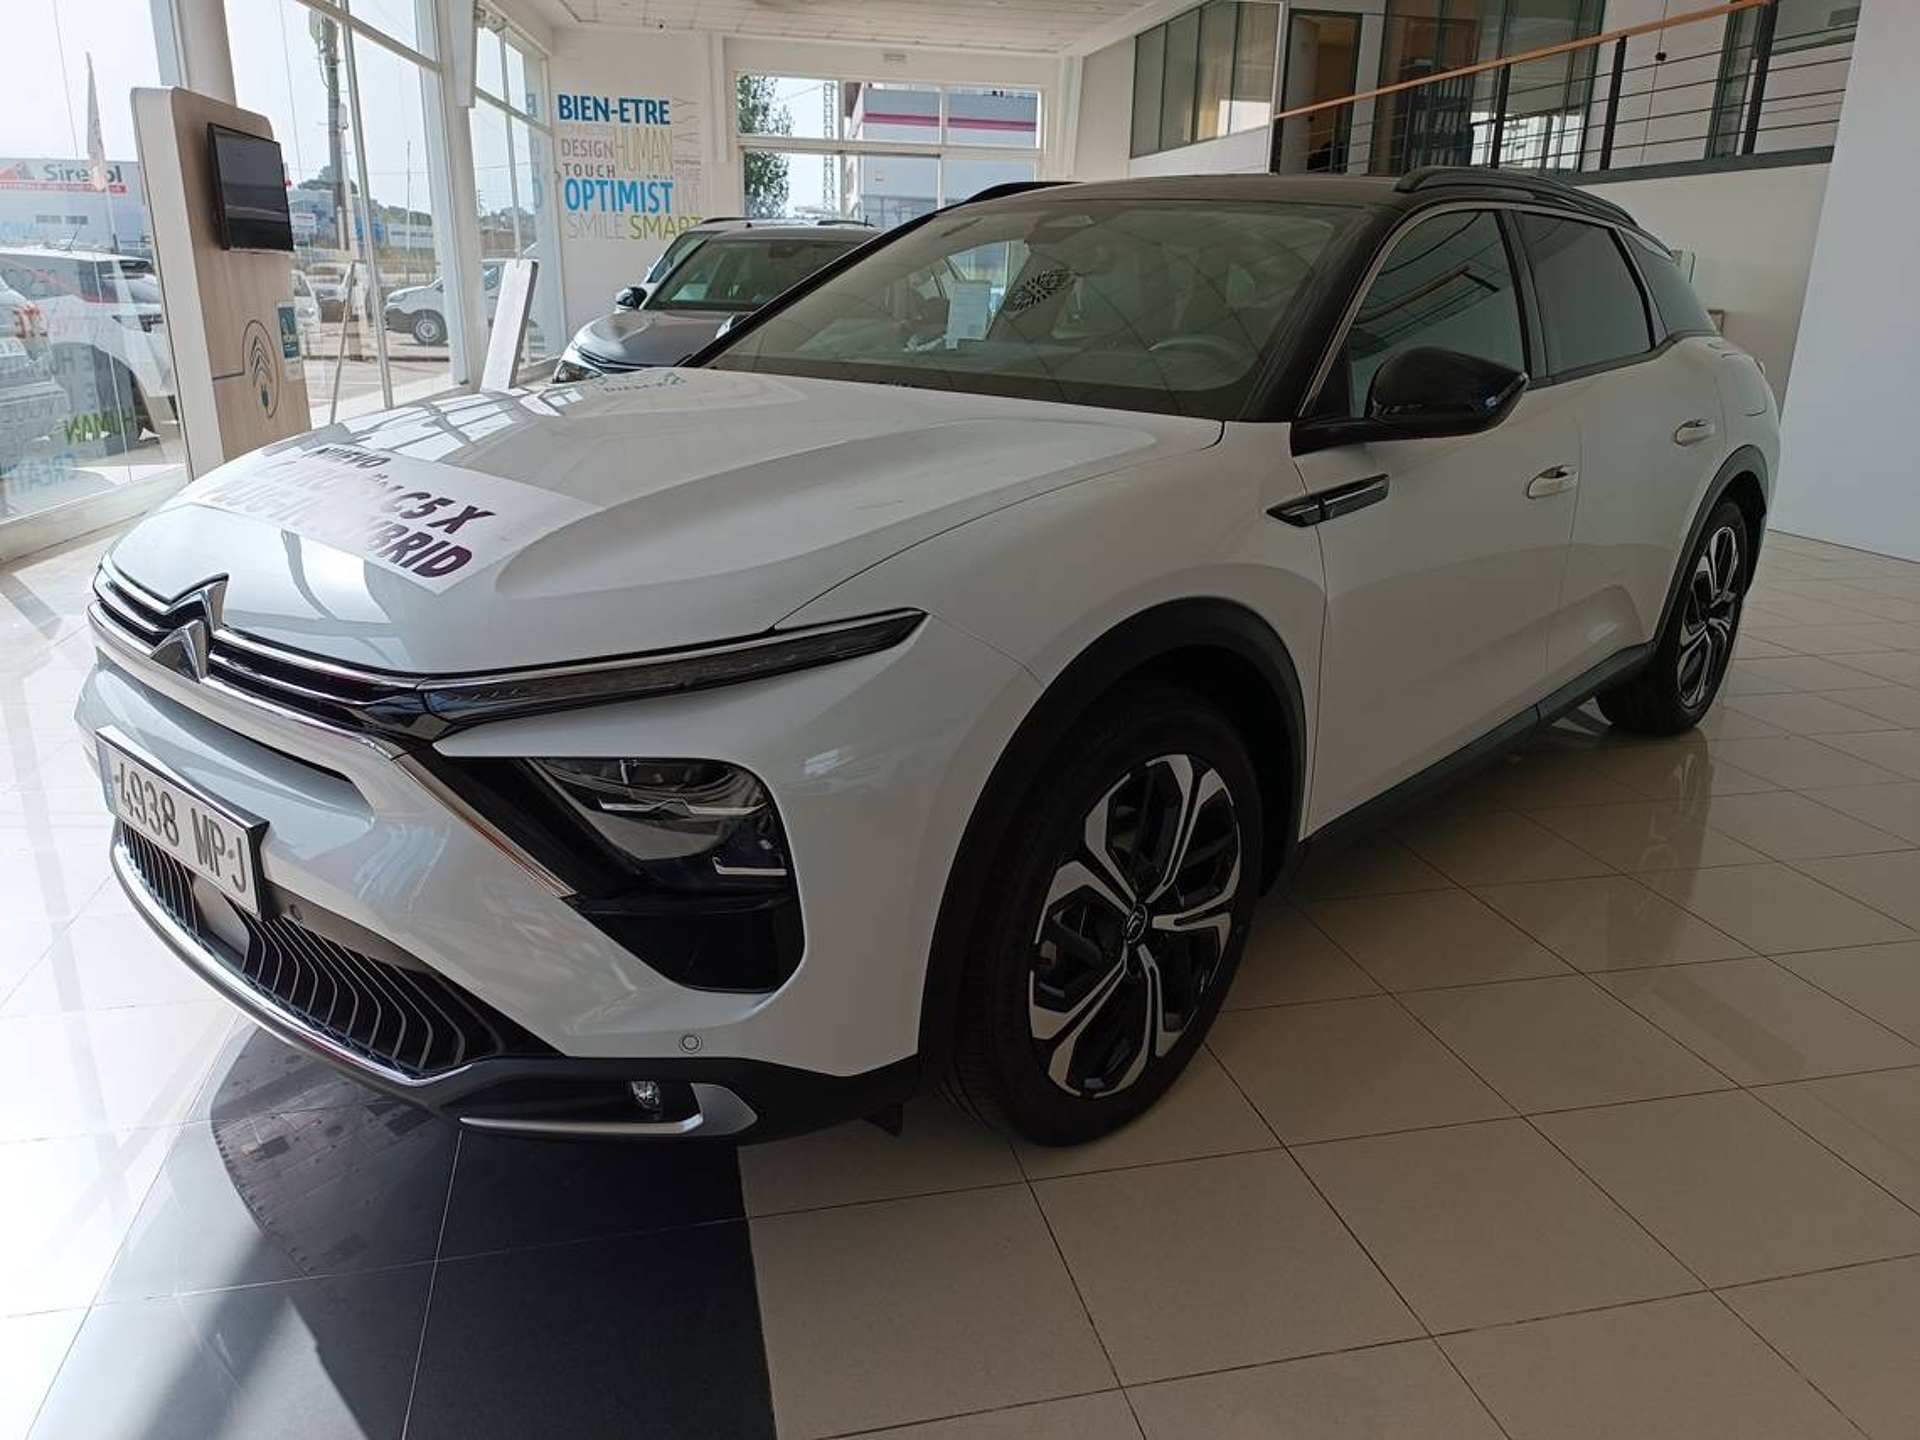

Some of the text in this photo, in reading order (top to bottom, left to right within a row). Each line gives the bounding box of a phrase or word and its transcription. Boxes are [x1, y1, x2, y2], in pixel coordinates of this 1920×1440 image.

[557, 94, 671, 125] BIEN-ETRE
[561, 138, 614, 159] DESIGN
[614, 127, 674, 173] HUMAN
[43, 163, 122, 184] Sireol
[563, 162, 616, 179] TOUCH
[565, 178, 674, 214] OPTIMIST
[567, 215, 626, 241] SMILE
[425, 505, 498, 534] X
[119, 763, 180, 848] 4938
